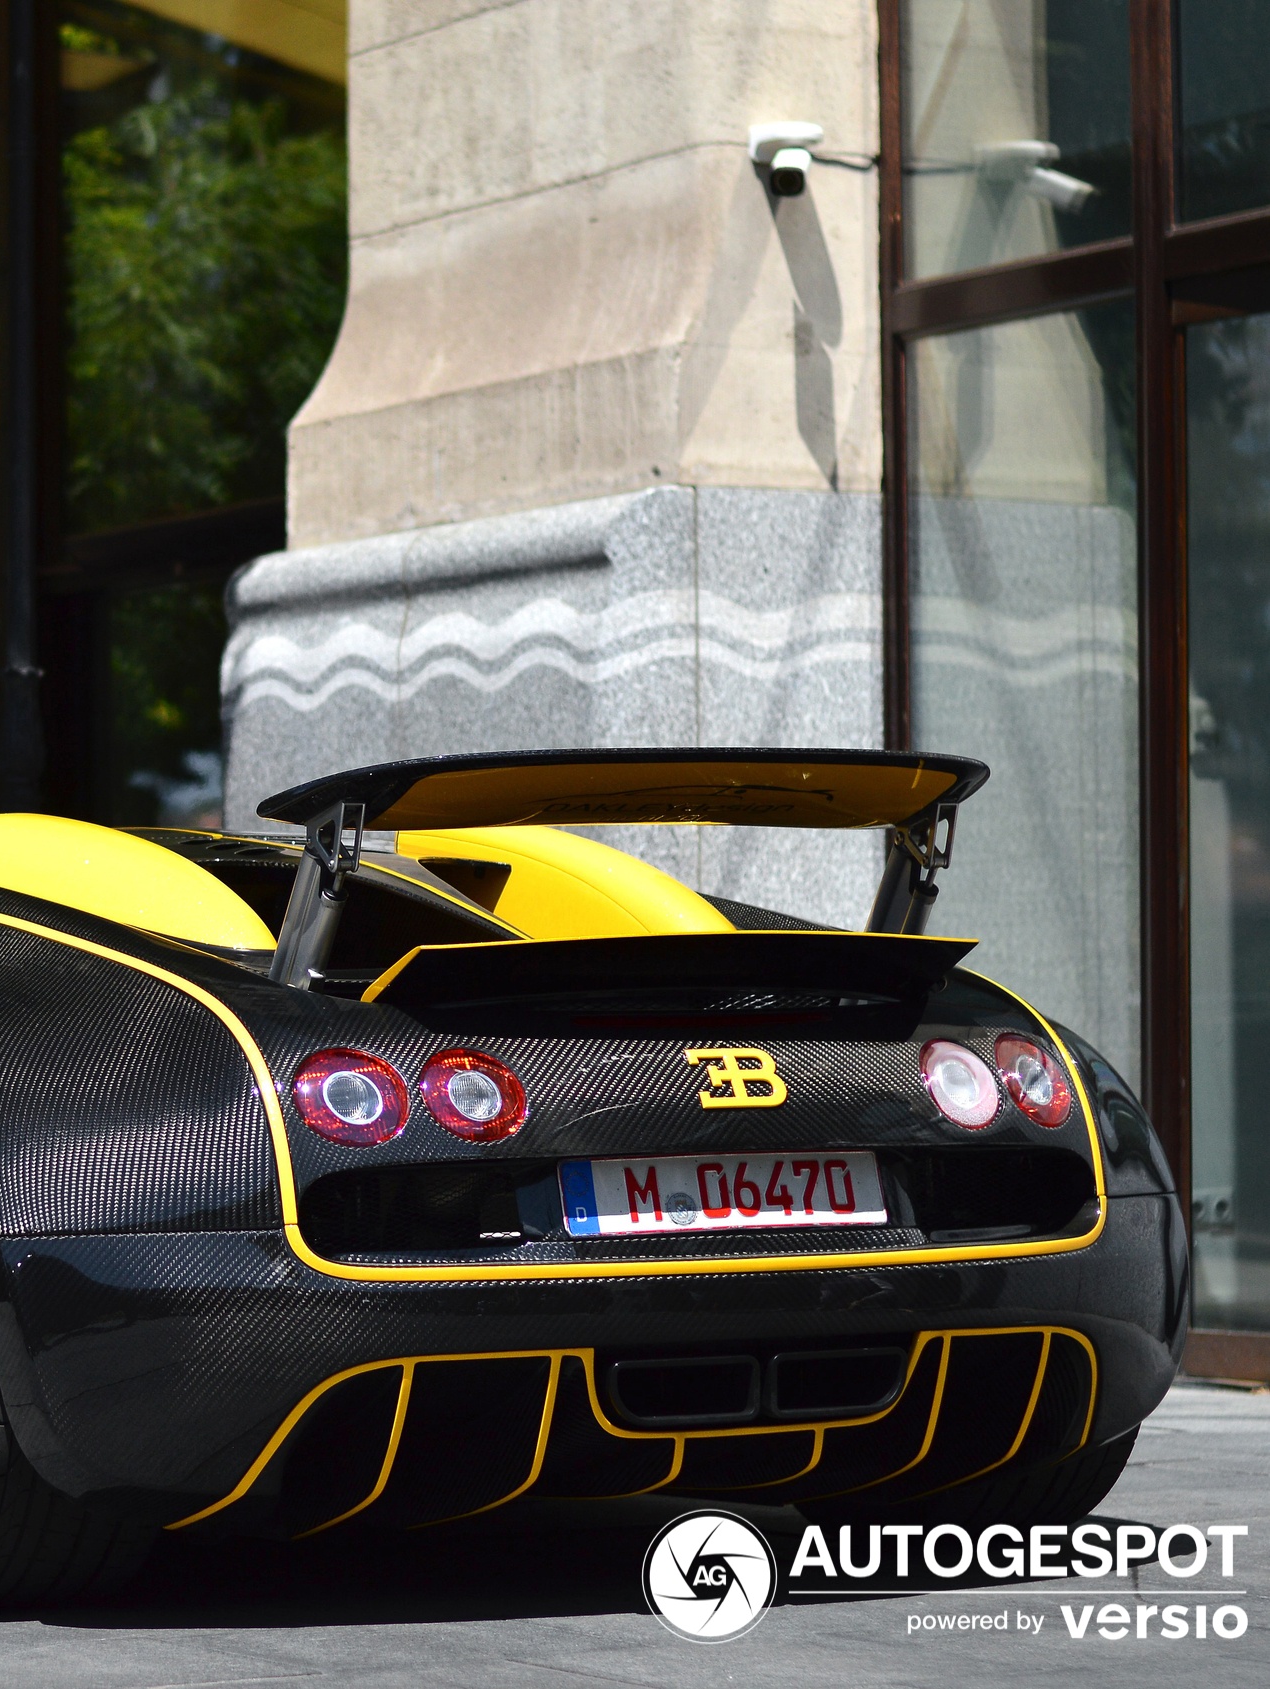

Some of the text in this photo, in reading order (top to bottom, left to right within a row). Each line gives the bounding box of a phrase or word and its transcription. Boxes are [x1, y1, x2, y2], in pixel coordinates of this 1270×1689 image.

[624, 1166, 663, 1223] M
[696, 1159, 857, 1219] 06470
[575, 1206, 589, 1223] D
